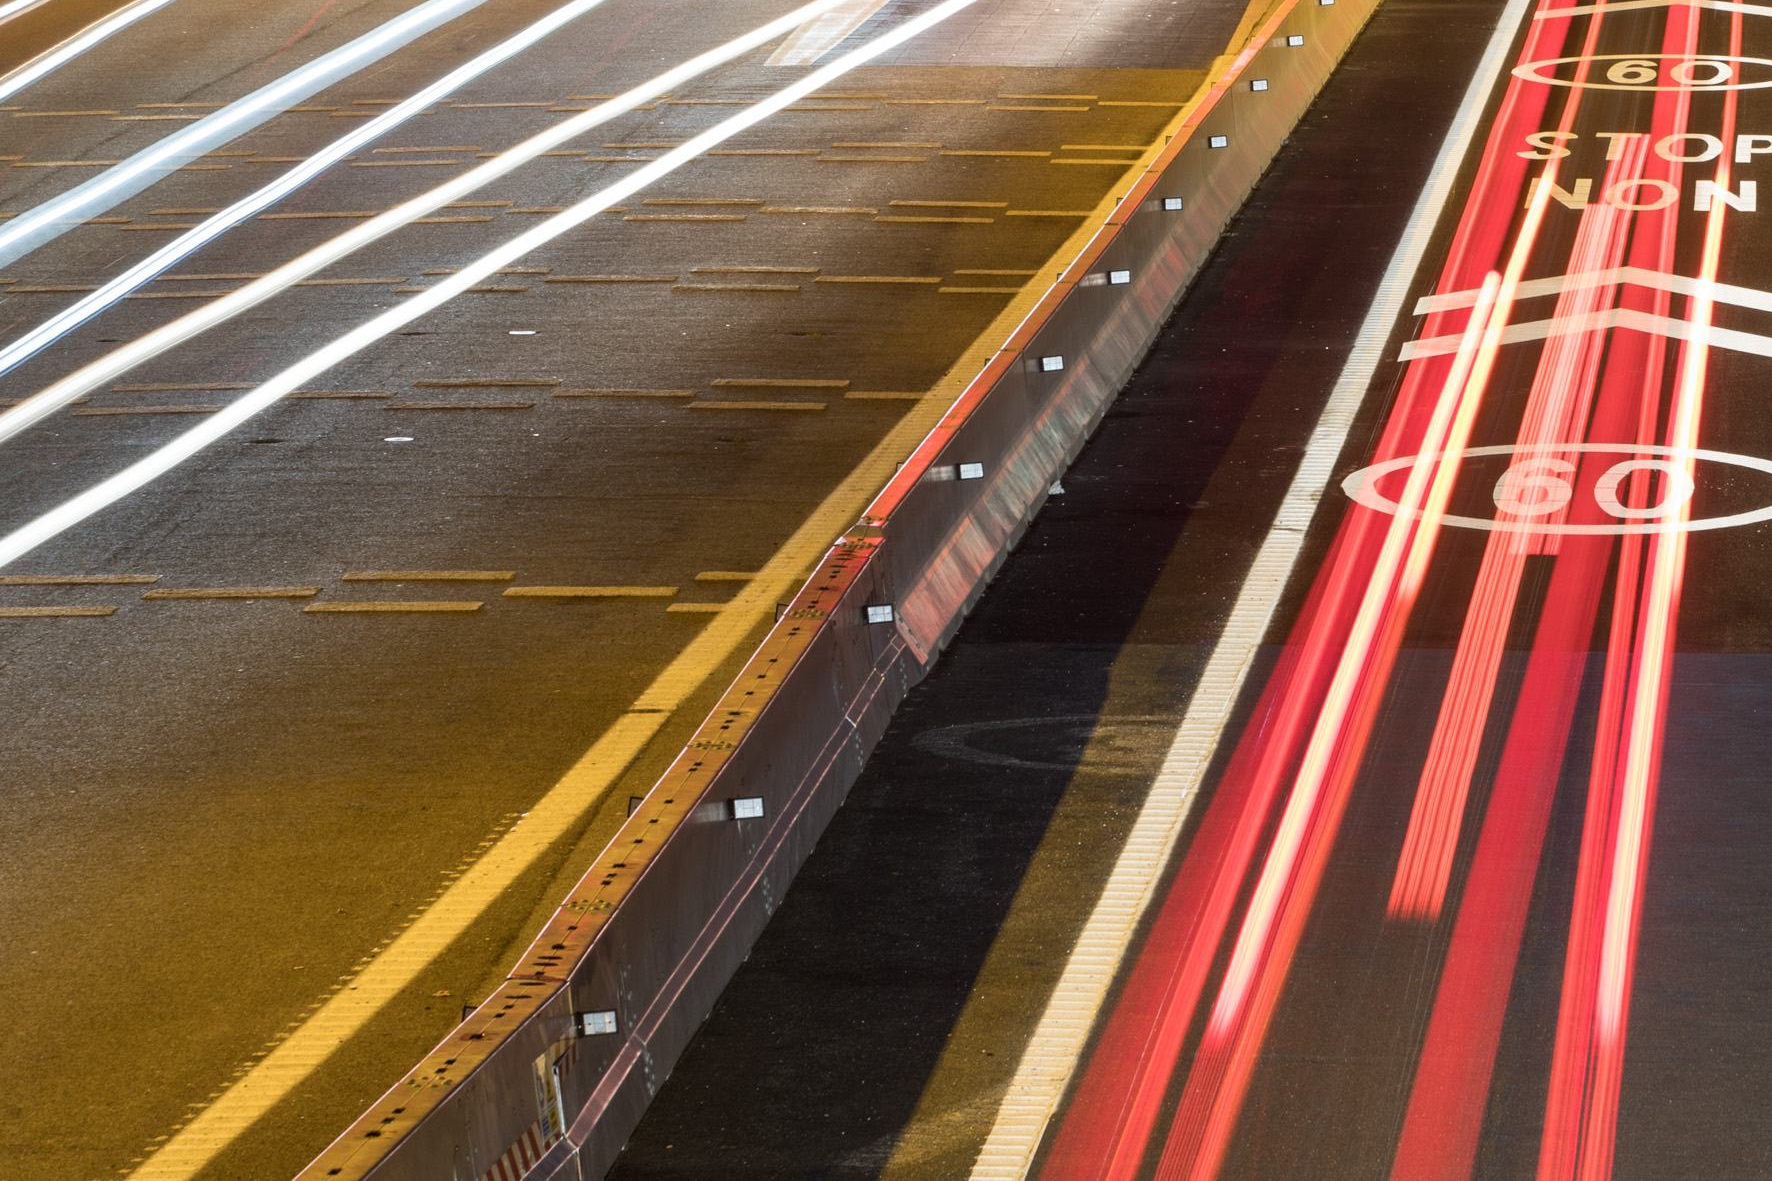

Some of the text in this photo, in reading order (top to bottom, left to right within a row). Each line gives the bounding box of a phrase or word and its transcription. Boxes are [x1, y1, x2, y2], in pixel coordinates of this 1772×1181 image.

[1605, 59, 1734, 85] 60
[1524, 177, 1757, 212] NON
[1492, 457, 1695, 520] 60
